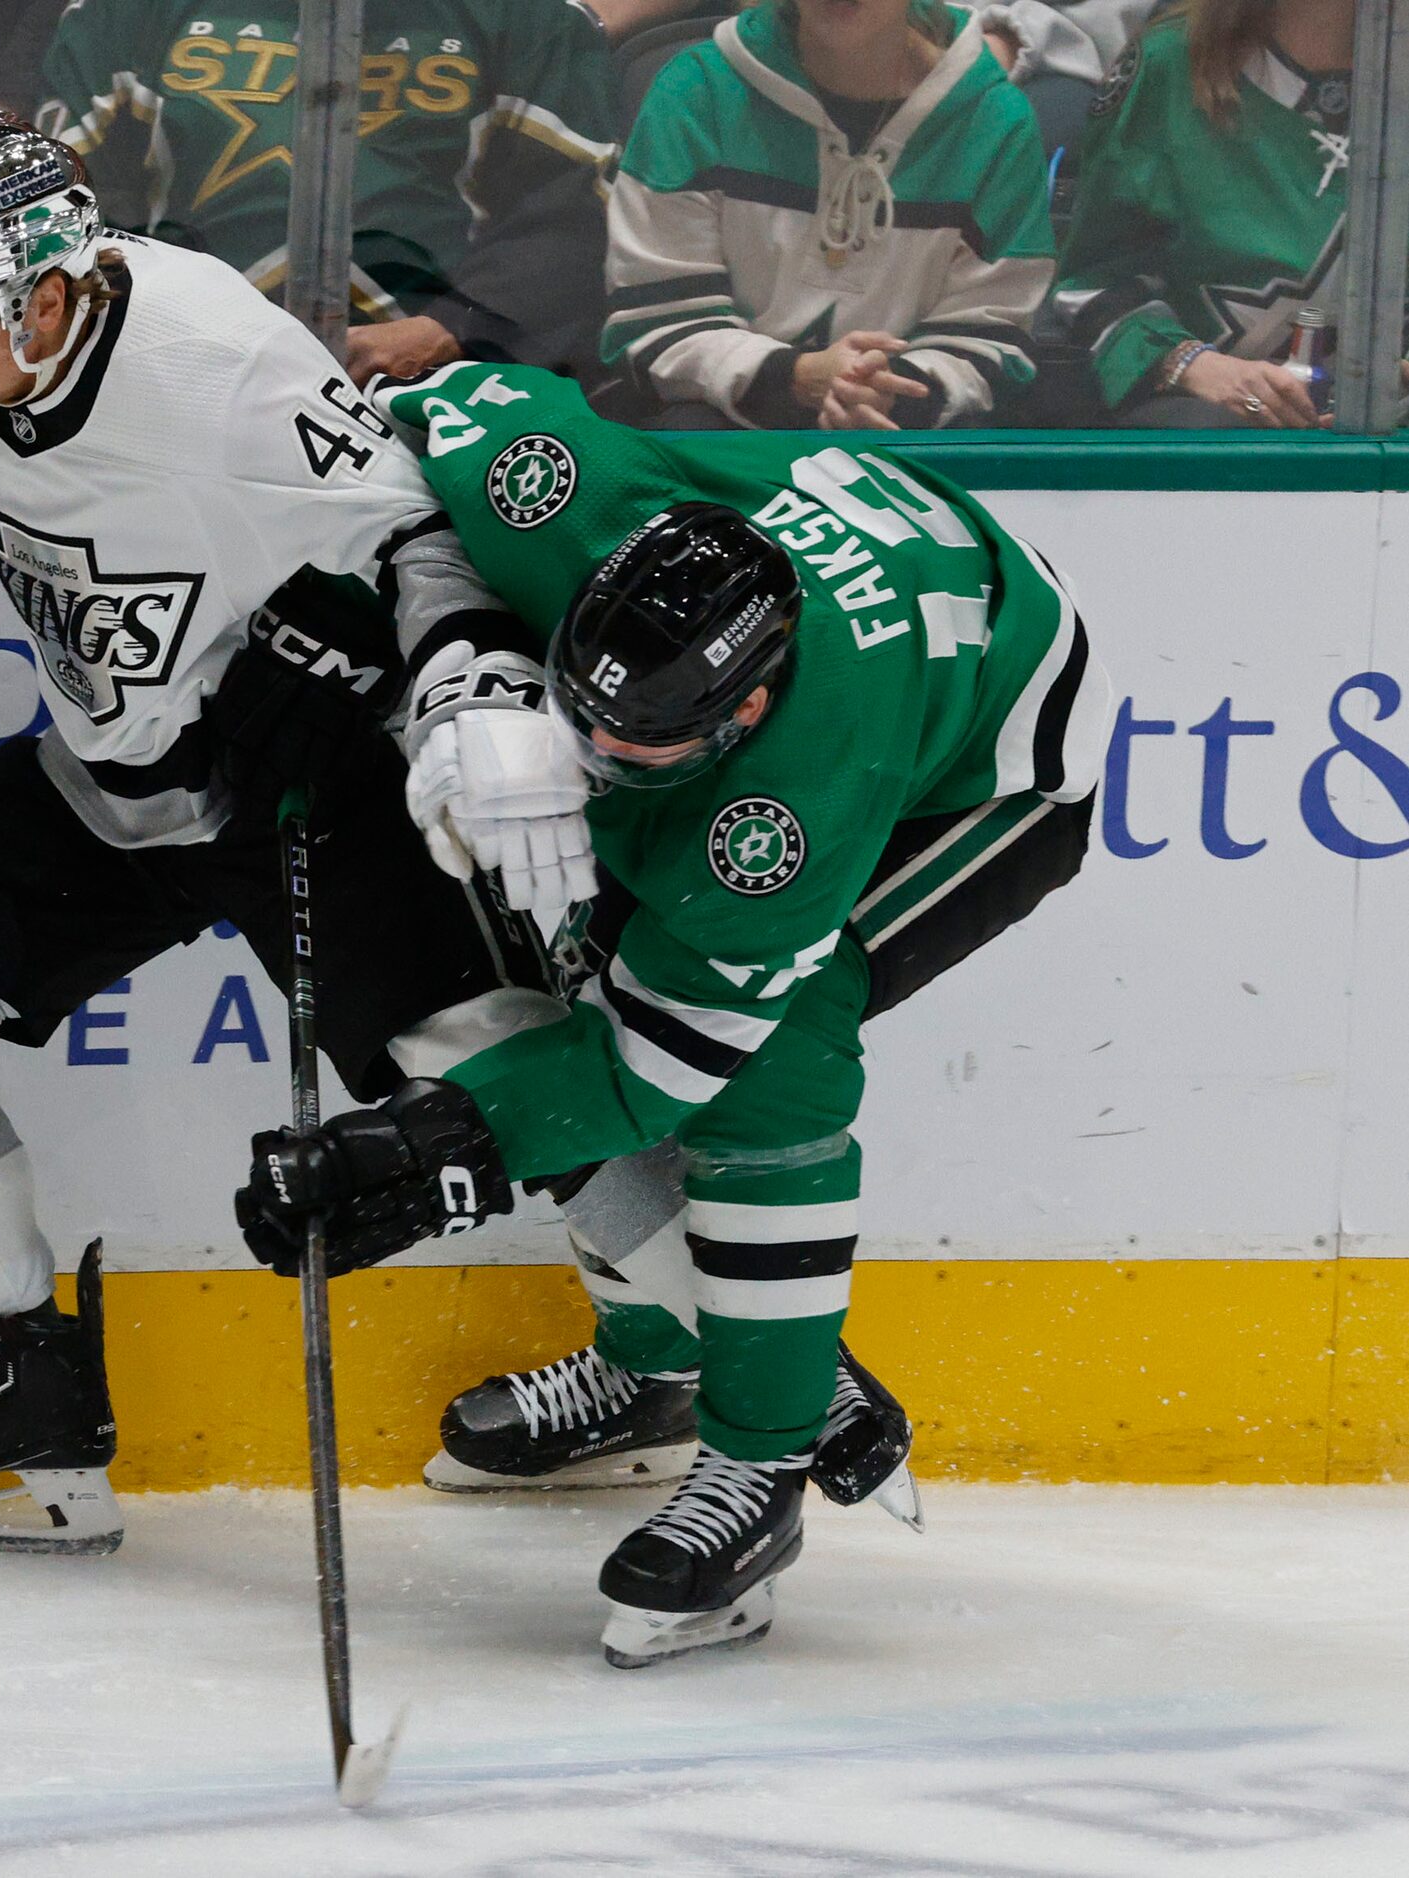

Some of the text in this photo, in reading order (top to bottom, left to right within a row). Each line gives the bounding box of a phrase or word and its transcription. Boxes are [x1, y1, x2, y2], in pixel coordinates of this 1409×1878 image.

[188, 21, 463, 54] DAAS
[161, 36, 480, 113] STRS
[0, 171, 65, 209] EXPRESS
[294, 376, 394, 480] 46
[492, 440, 545, 497] STARS
[510, 458, 570, 522] DALLAS
[11, 543, 78, 580] Los Angeles
[749, 488, 912, 651] FAKSA
[722, 594, 762, 642] ENERGY
[730, 593, 777, 649] TRANSFER
[250, 605, 385, 696] CCM
[589, 653, 628, 698] 12
[713, 804, 791, 850] DALLAS
[726, 850, 798, 888] STARS
[268, 1155, 292, 1204] CCM
[569, 1430, 633, 1459] BAUER
